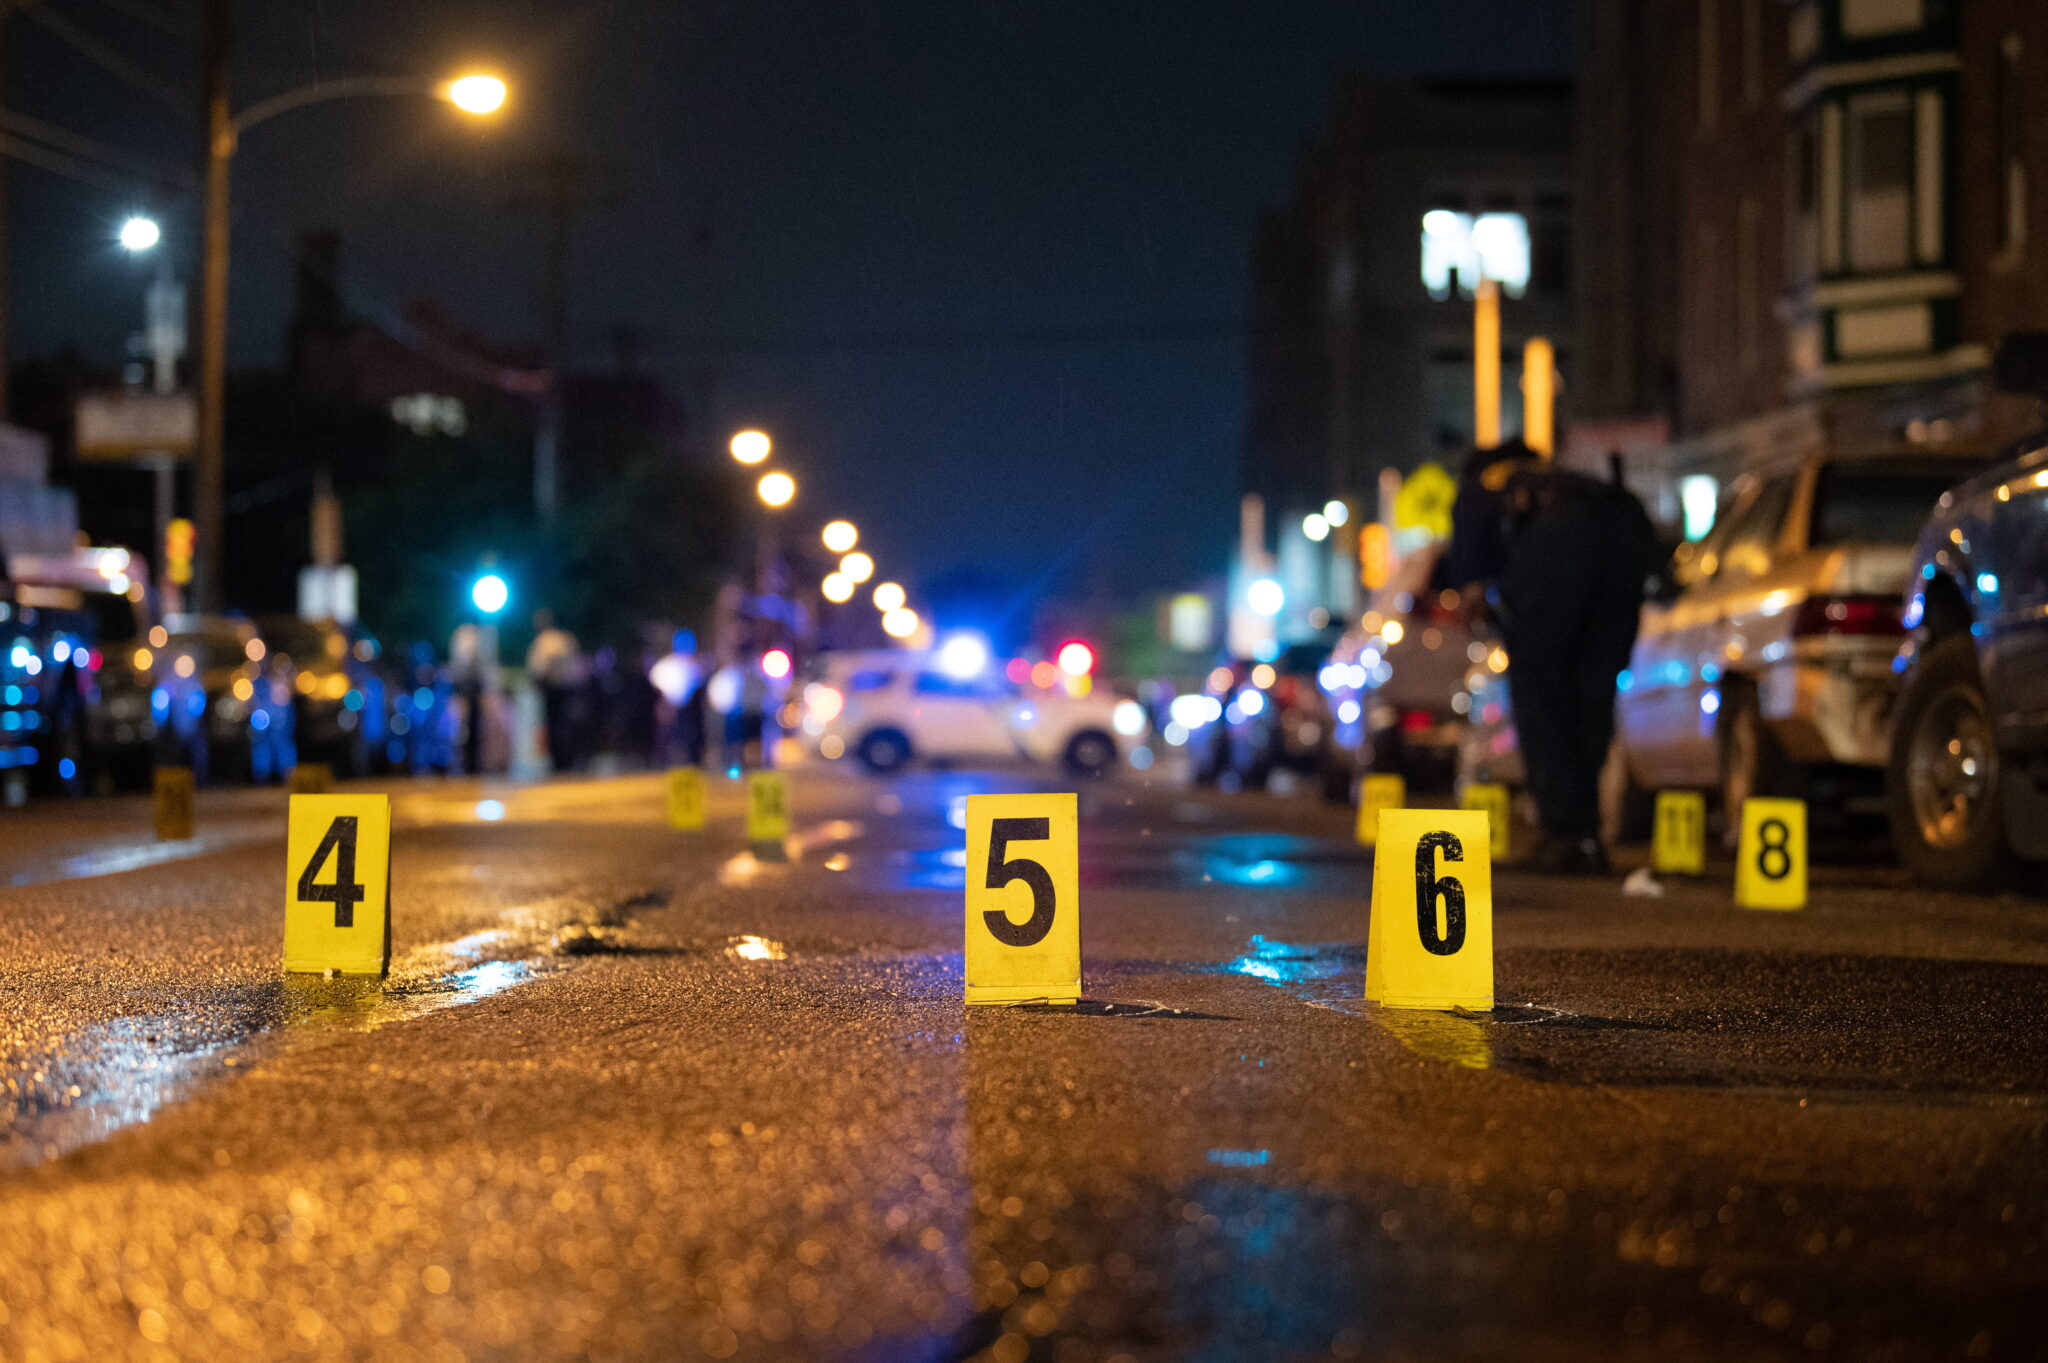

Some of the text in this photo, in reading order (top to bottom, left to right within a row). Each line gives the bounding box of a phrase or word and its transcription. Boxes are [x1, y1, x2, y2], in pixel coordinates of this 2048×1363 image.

[297, 815, 365, 929] 4
[983, 817, 1056, 946] 5
[1414, 830, 1467, 957] 6
[1757, 818, 1792, 881] 8
